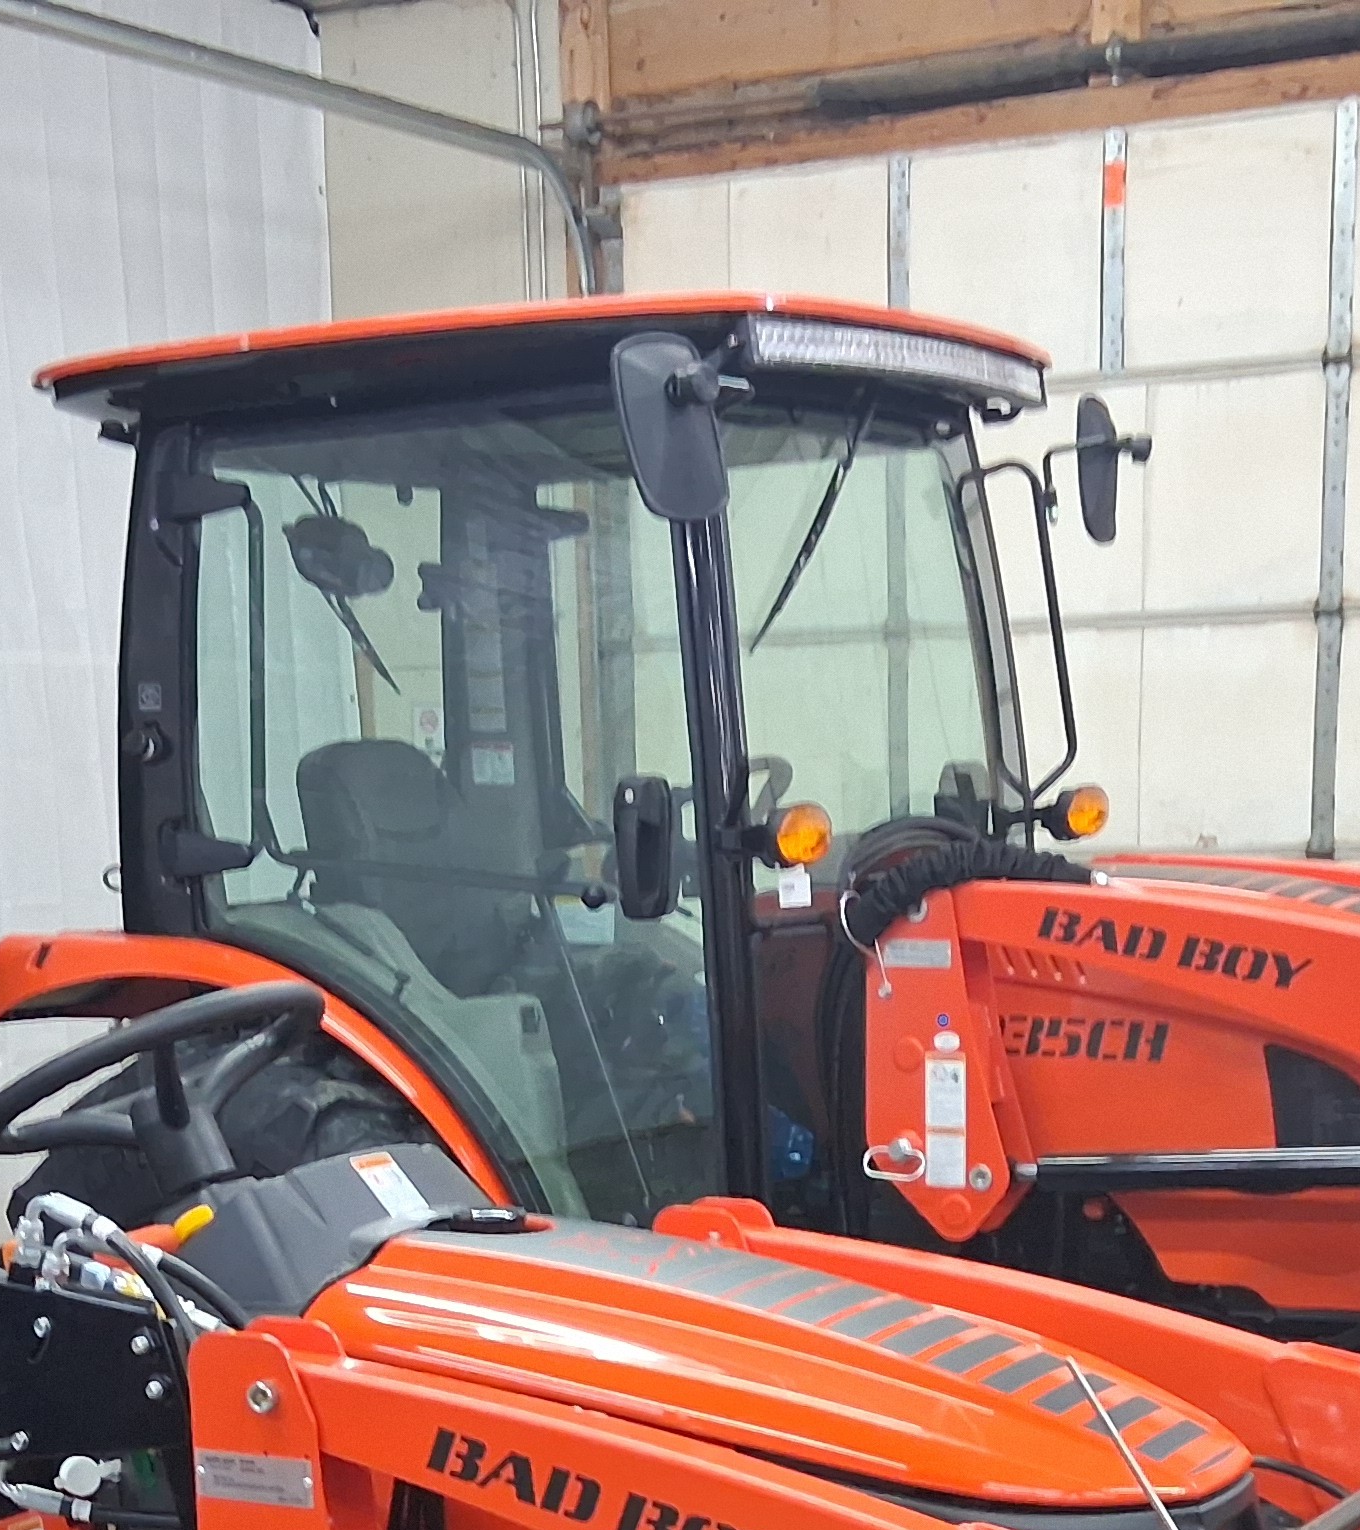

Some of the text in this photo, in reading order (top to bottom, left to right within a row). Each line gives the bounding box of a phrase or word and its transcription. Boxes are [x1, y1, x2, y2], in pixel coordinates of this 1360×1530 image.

[1038, 906, 1315, 991] BAD BOY
[999, 1014, 1170, 1063] 35CH
[426, 1426, 603, 1524] BAD
